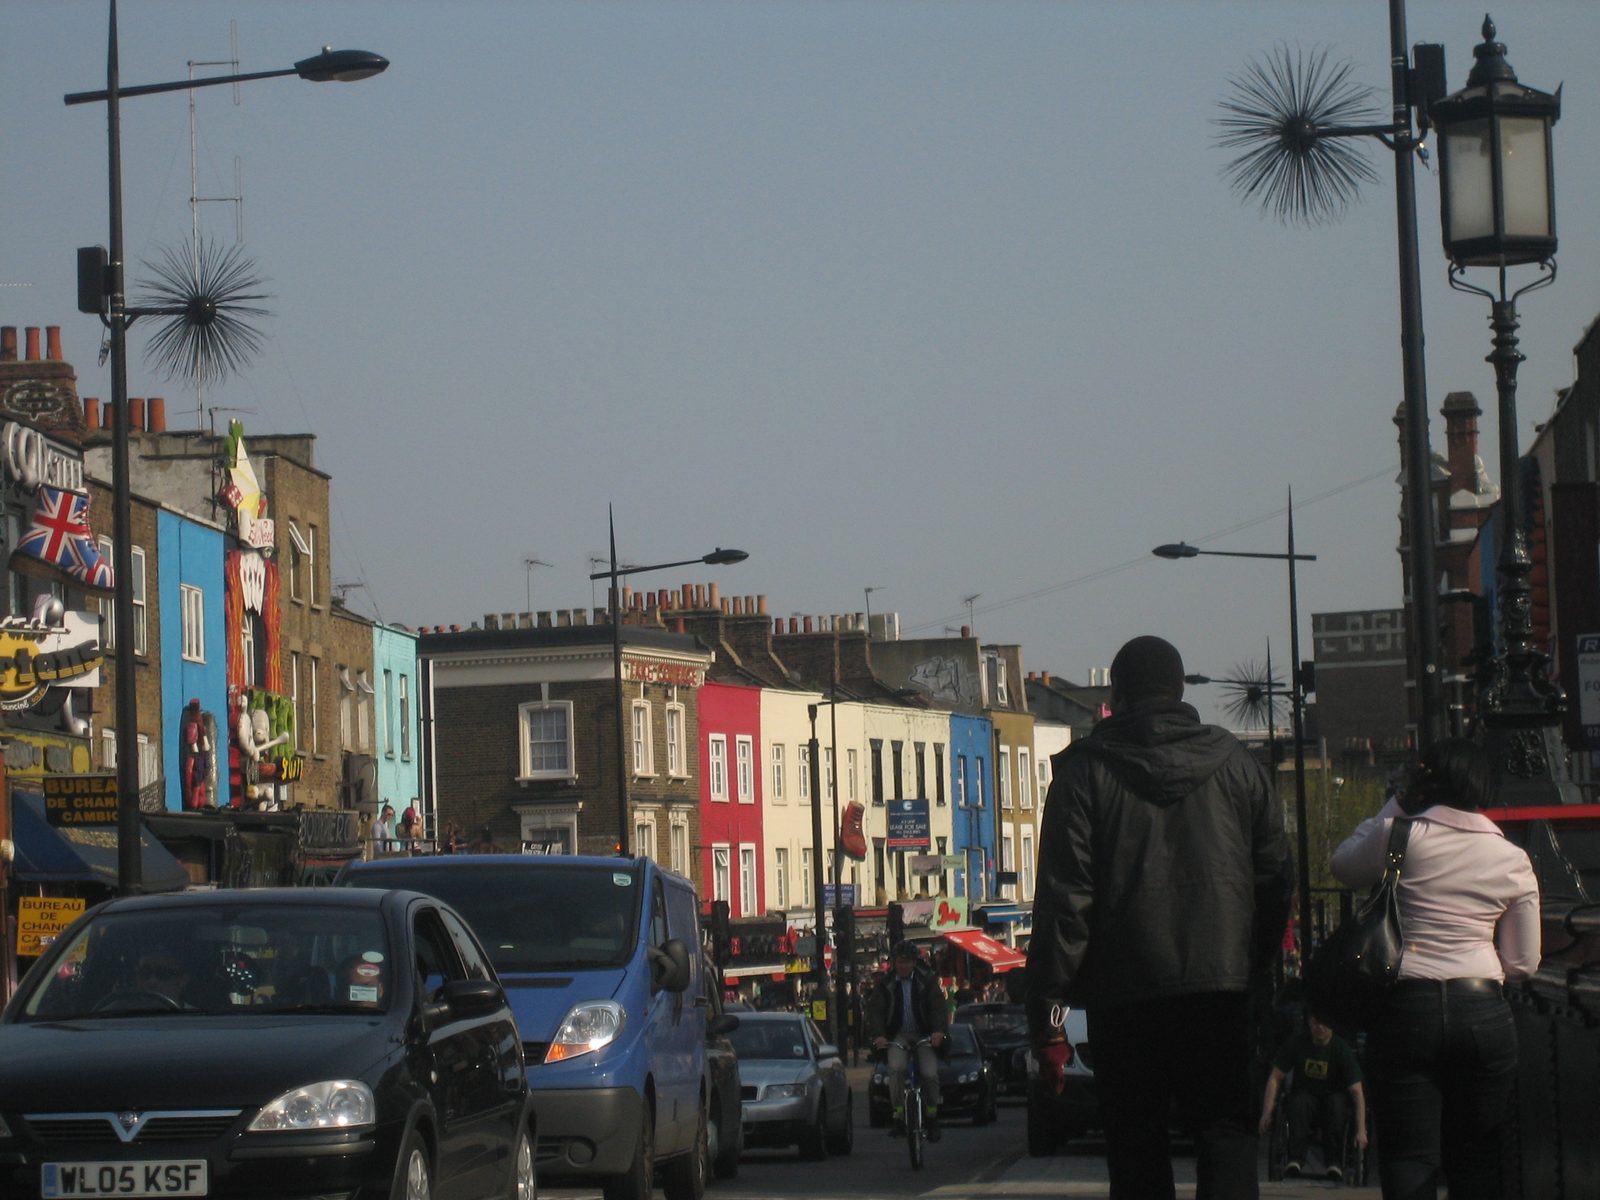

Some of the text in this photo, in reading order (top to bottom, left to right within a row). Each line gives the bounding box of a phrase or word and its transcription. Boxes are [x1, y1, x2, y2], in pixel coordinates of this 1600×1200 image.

[47, 778, 118, 793] BUREA
[47, 797, 119, 809] DE CHAN
[22, 900, 82, 911] BUREAU
[40, 911, 57, 920] DE
[61, 1164, 202, 1194] WL05 KSF
